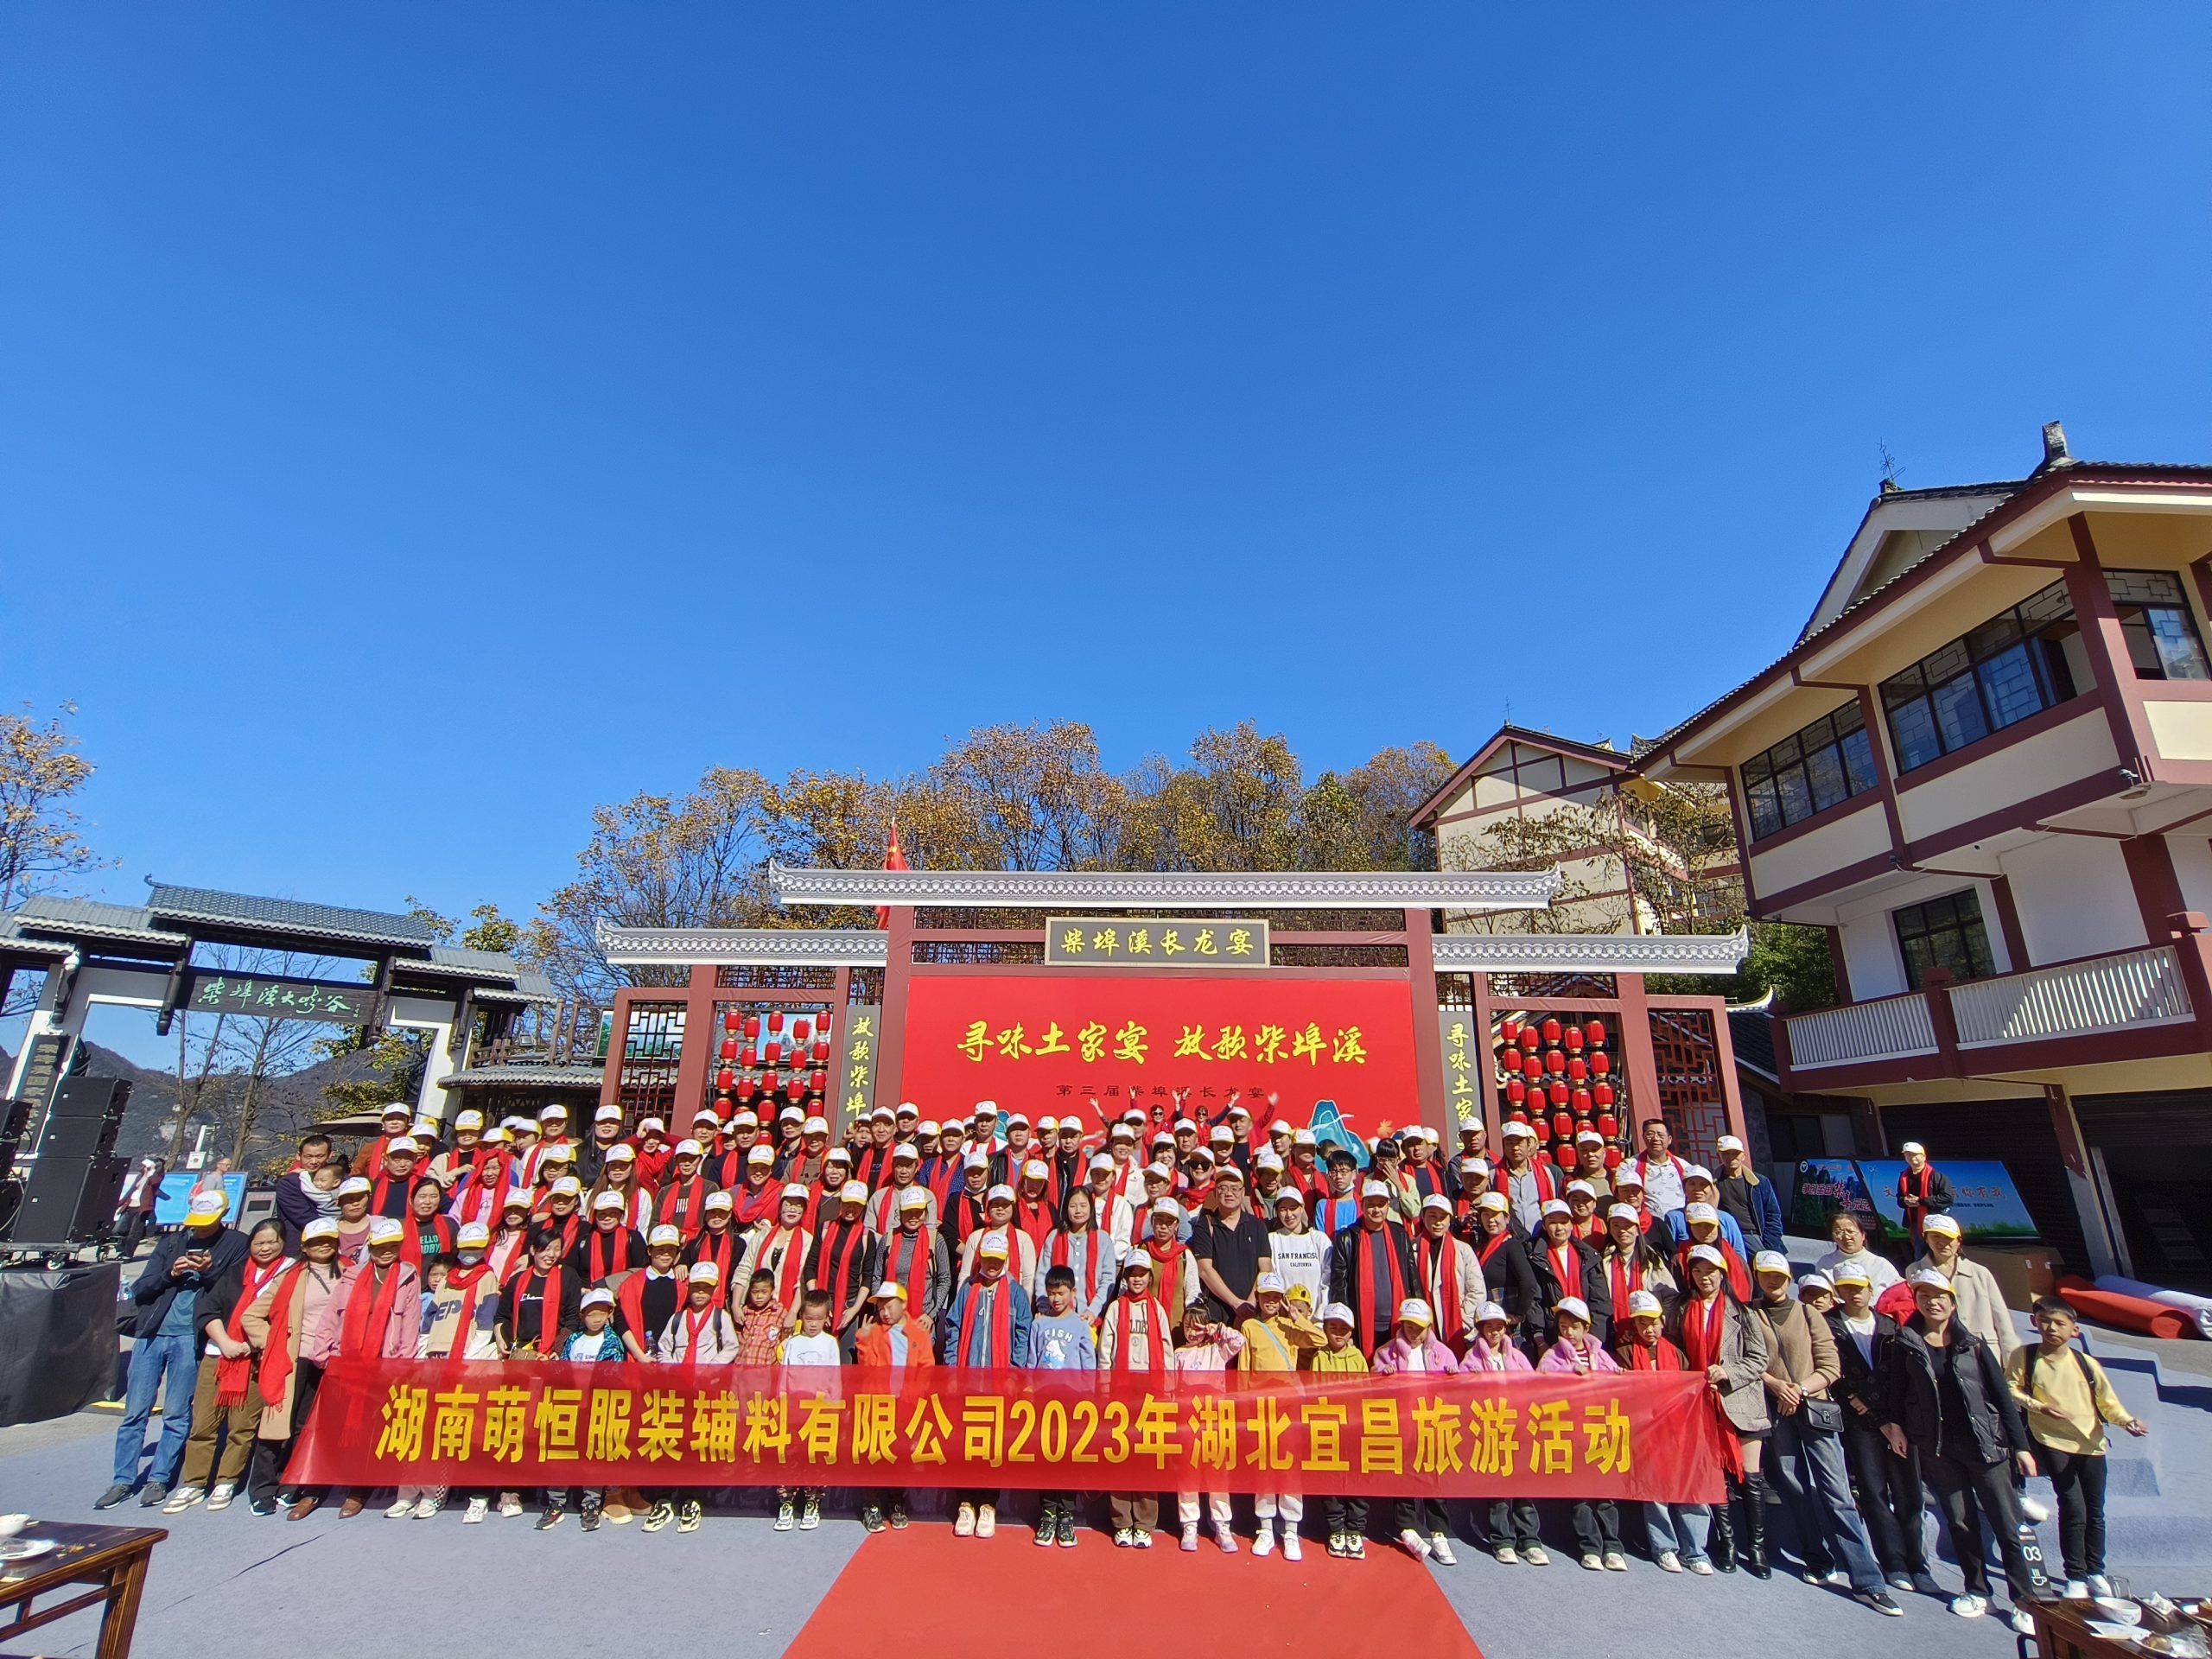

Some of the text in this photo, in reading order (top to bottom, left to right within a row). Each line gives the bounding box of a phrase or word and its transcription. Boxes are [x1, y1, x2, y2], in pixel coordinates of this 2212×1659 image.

[1061, 928, 1254, 957] 柴埠溪长龙宴
[957, 1020, 1368, 1066] 寻味土家宴 放歌柴埠溪
[846, 1016, 874, 1118] 放歌柴埠
[1446, 1023, 1473, 1150] 寻味土家
[1044, 1327, 1073, 1342] FISH
[375, 1382, 1632, 1477] 湖南萌恒服装辅料有限公司2023年湖北宜昌旅游活动
[2023, 1545, 2042, 1561] 03
